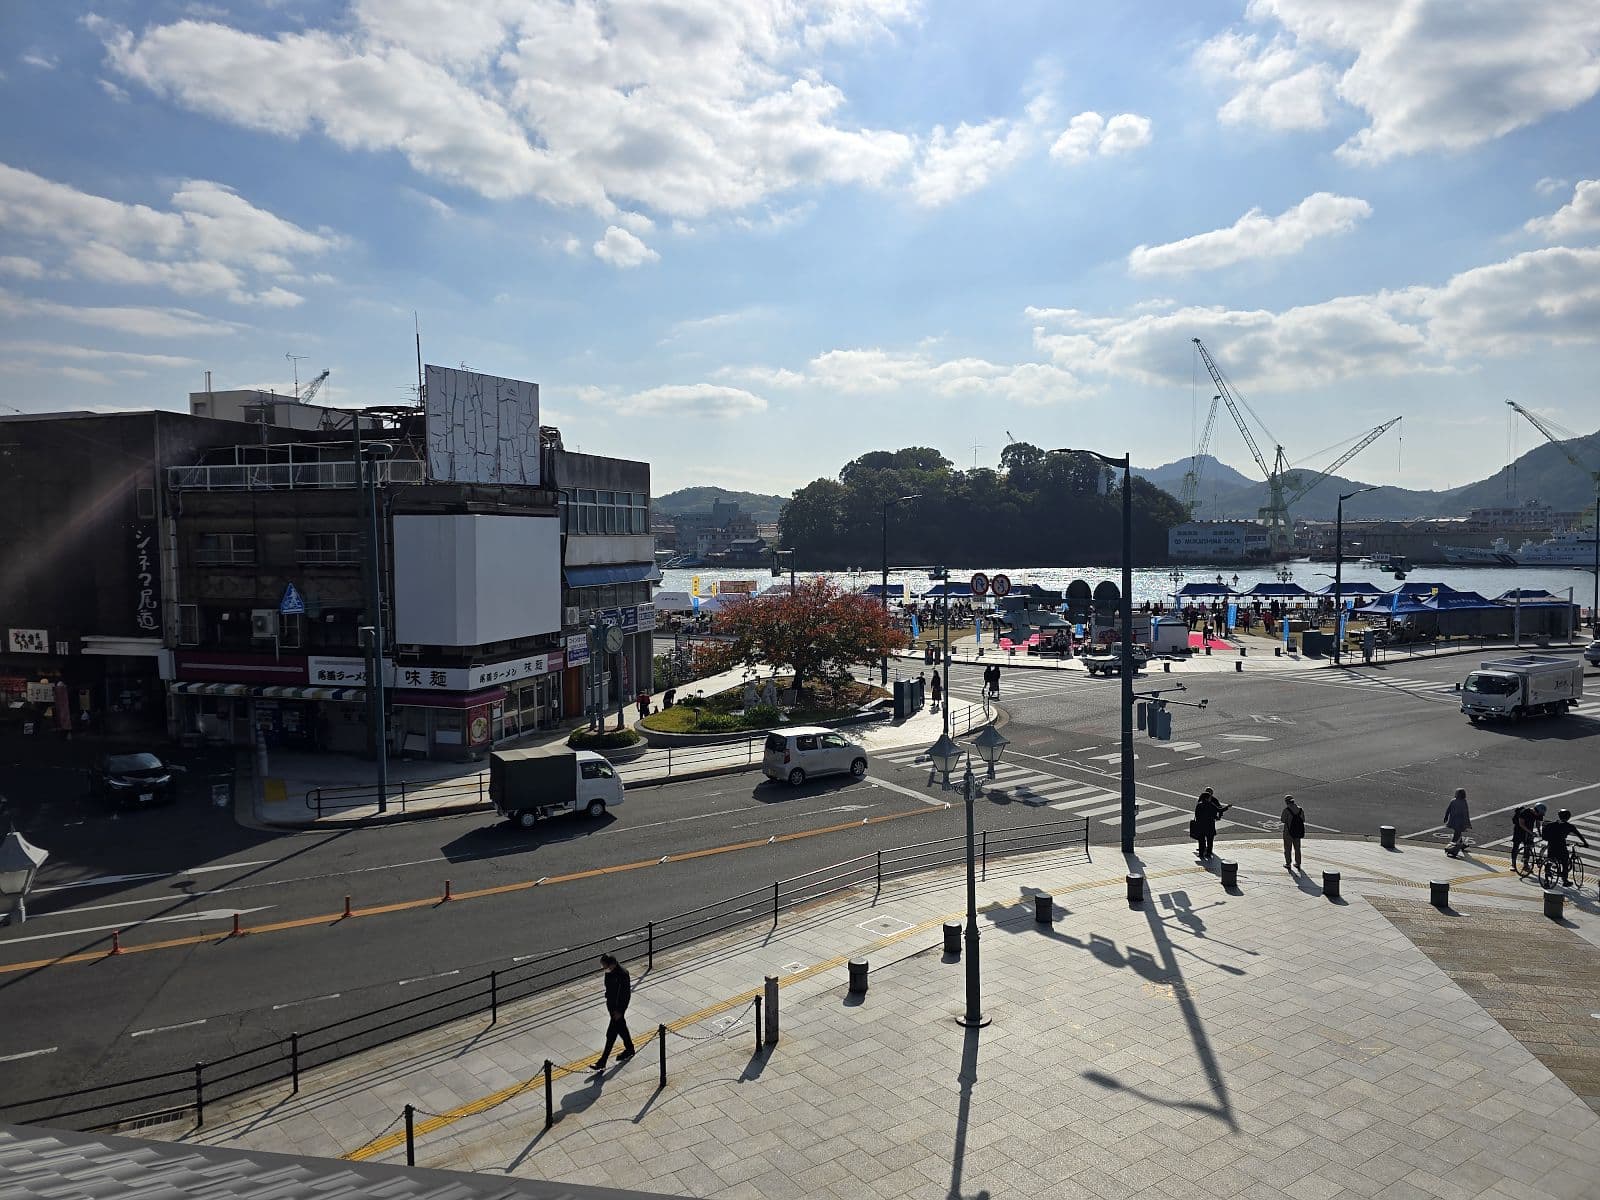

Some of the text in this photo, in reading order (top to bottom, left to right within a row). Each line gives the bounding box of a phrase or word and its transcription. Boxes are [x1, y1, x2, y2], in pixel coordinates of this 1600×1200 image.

[136, 530, 159, 630] シネマ尾道
